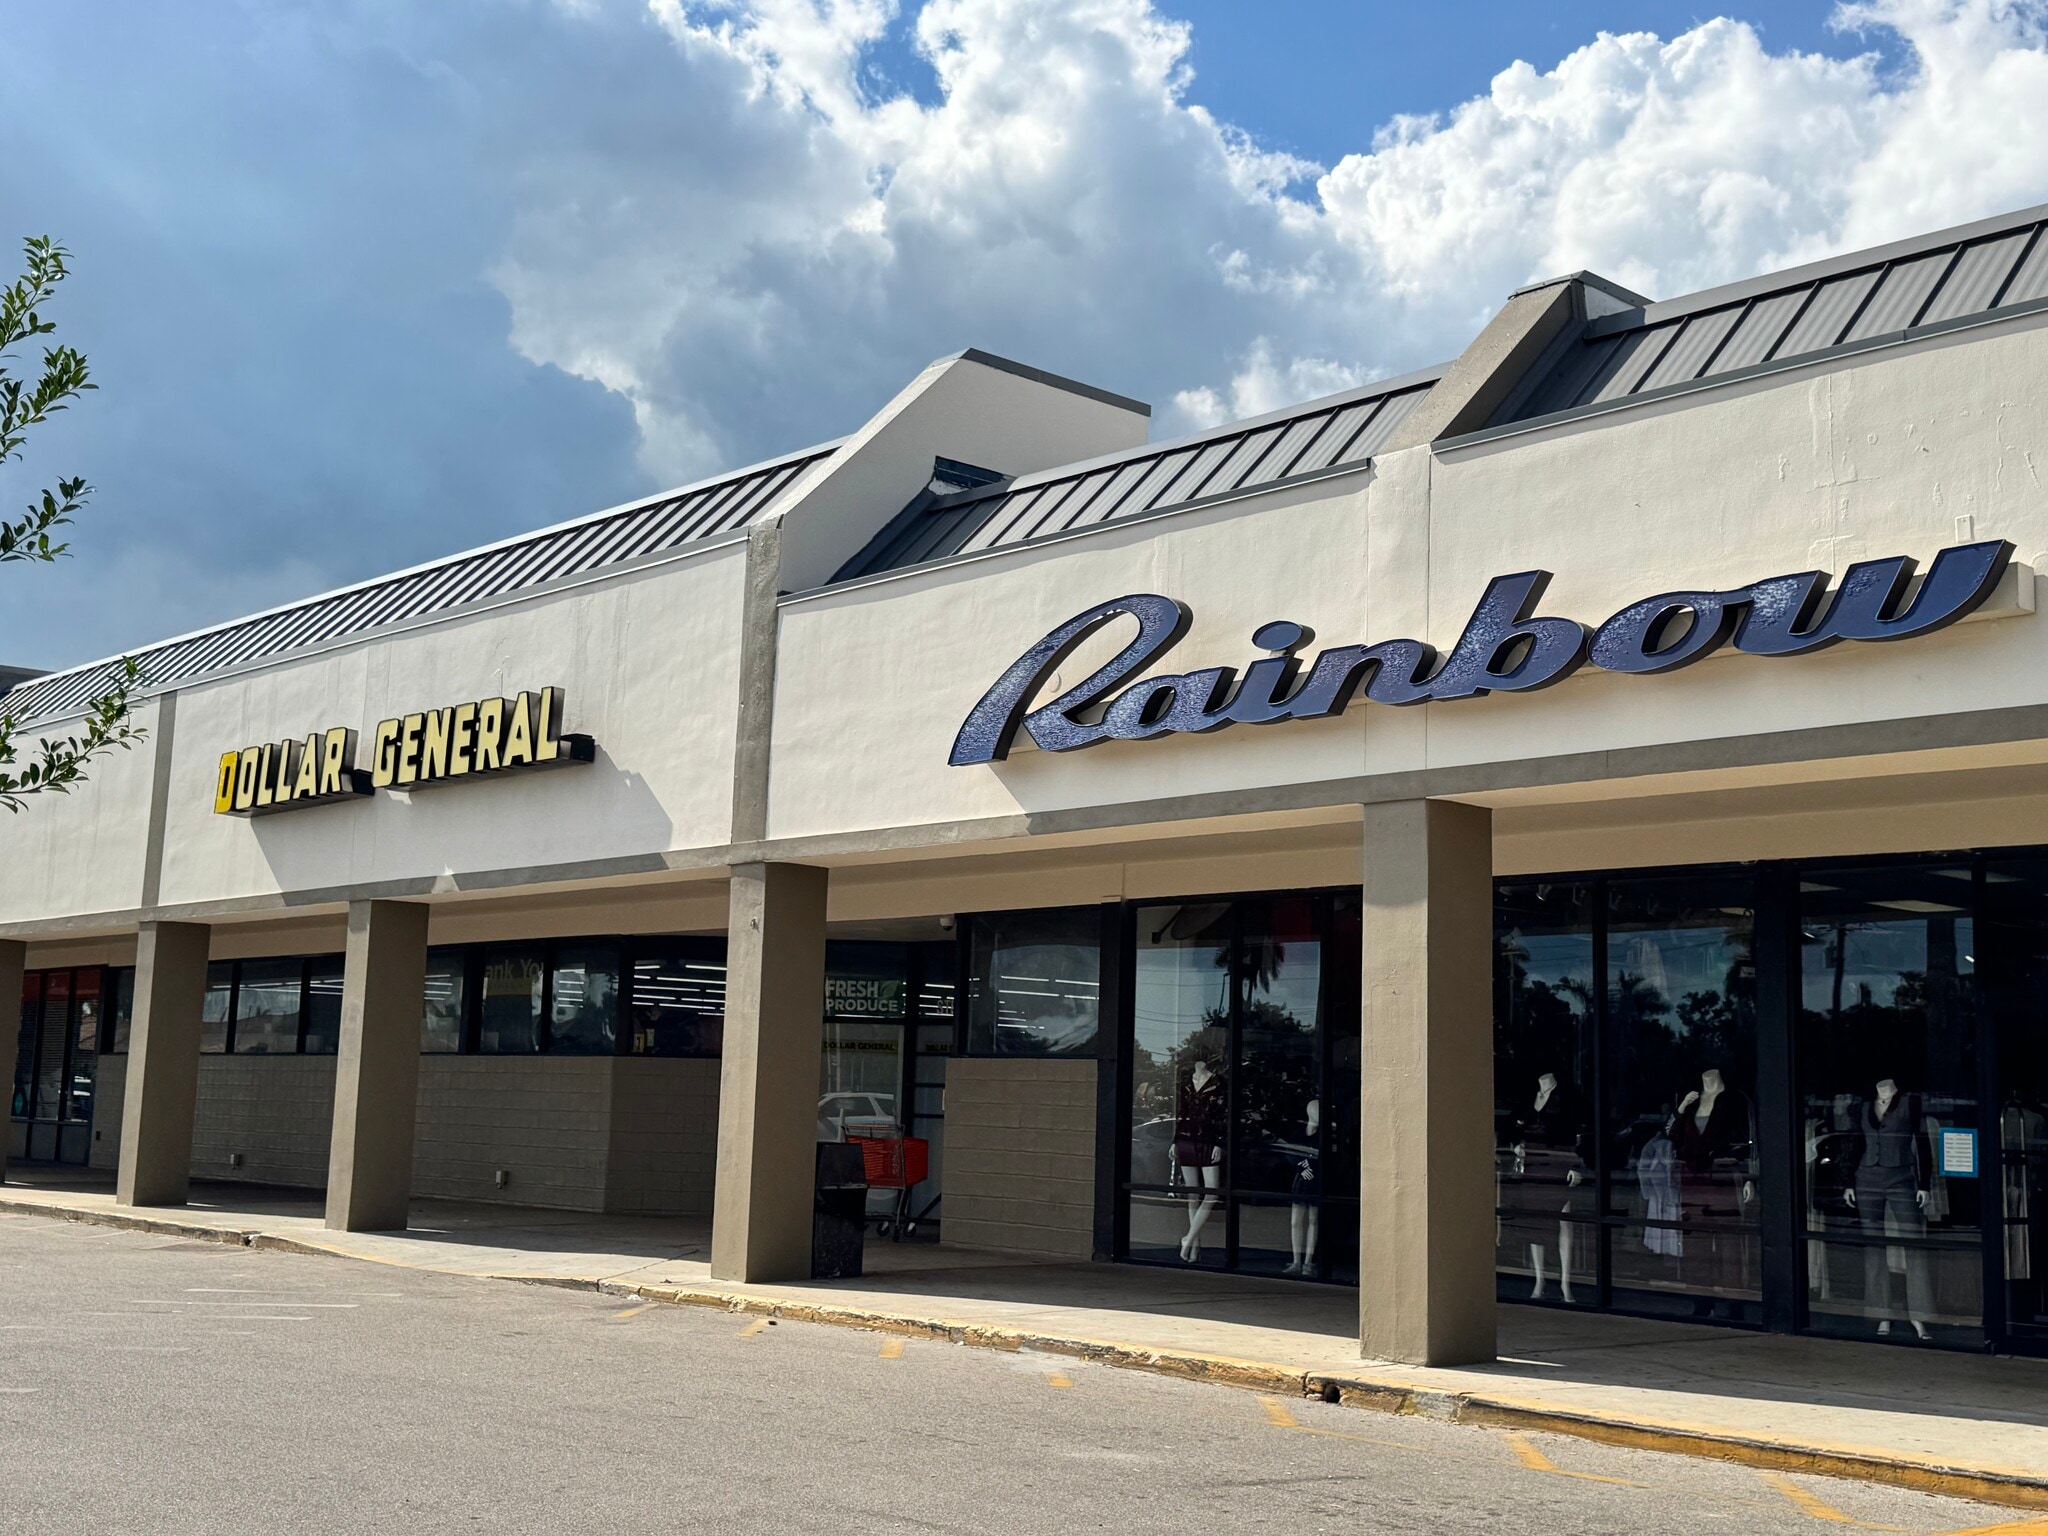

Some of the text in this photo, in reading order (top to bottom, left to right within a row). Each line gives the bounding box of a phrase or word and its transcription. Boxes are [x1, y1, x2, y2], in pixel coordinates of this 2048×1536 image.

[946, 538, 2014, 767] Rainbow
[214, 685, 564, 814] DOLLAR GENERAL
[825, 980, 879, 998] FRESH
[825, 999, 898, 1012] PRODUCE
[858, 1042, 896, 1051] GENERAL
